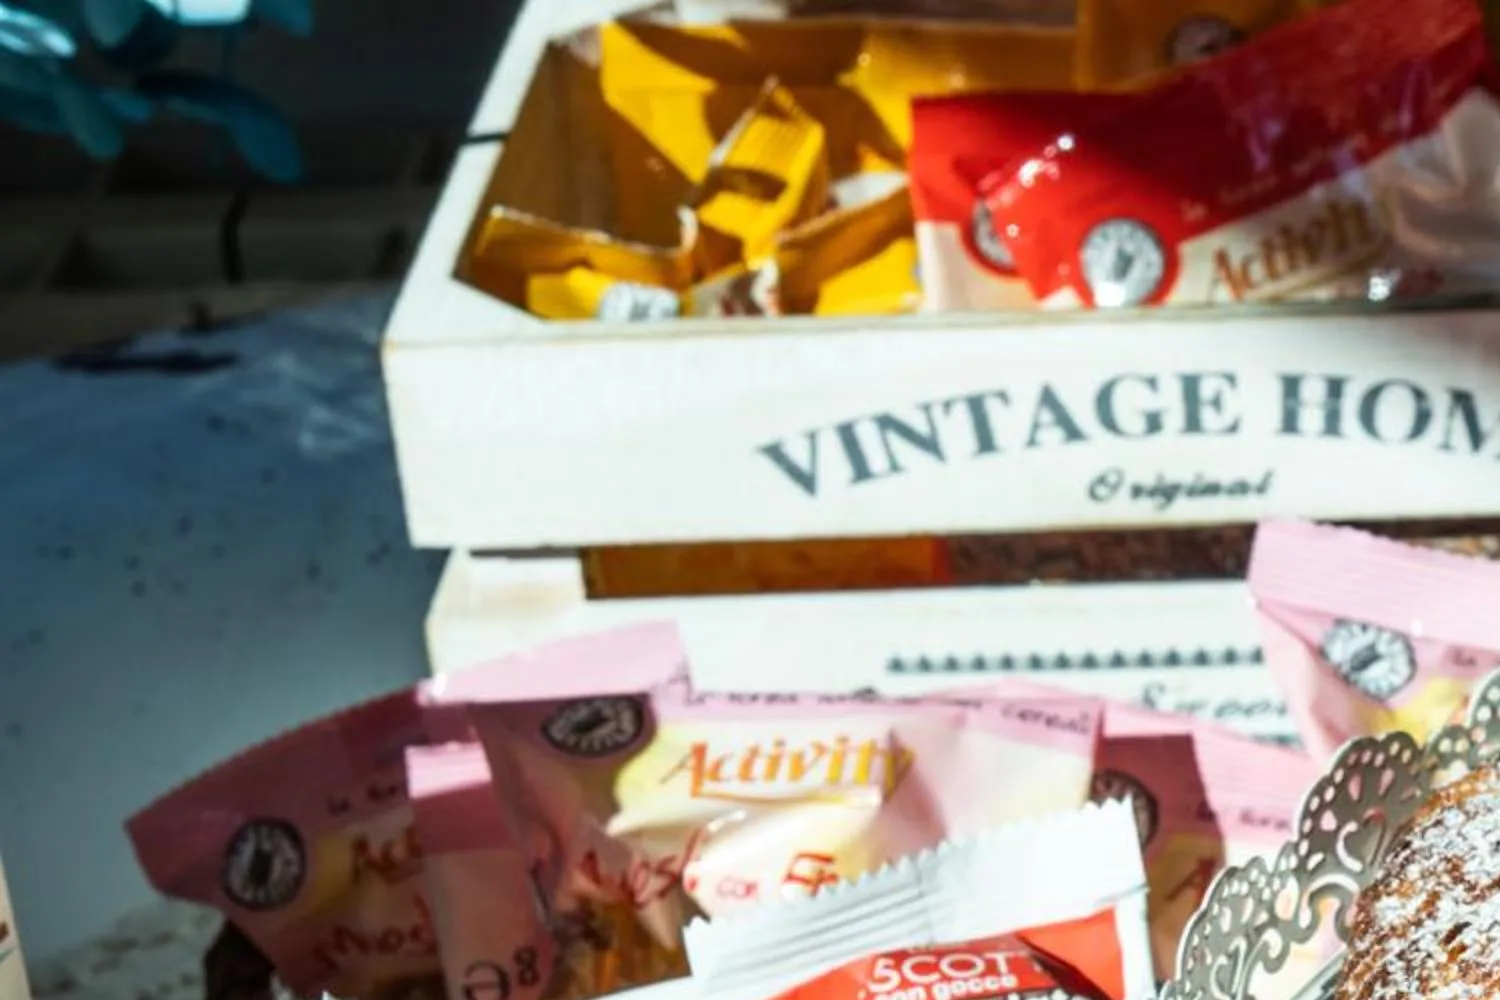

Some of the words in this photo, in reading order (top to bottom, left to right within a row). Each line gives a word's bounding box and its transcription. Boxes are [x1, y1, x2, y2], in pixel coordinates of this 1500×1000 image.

[755, 370, 1241, 499] VINTAGE
[1086, 468, 1274, 511] Original
[658, 728, 917, 804] Activity
